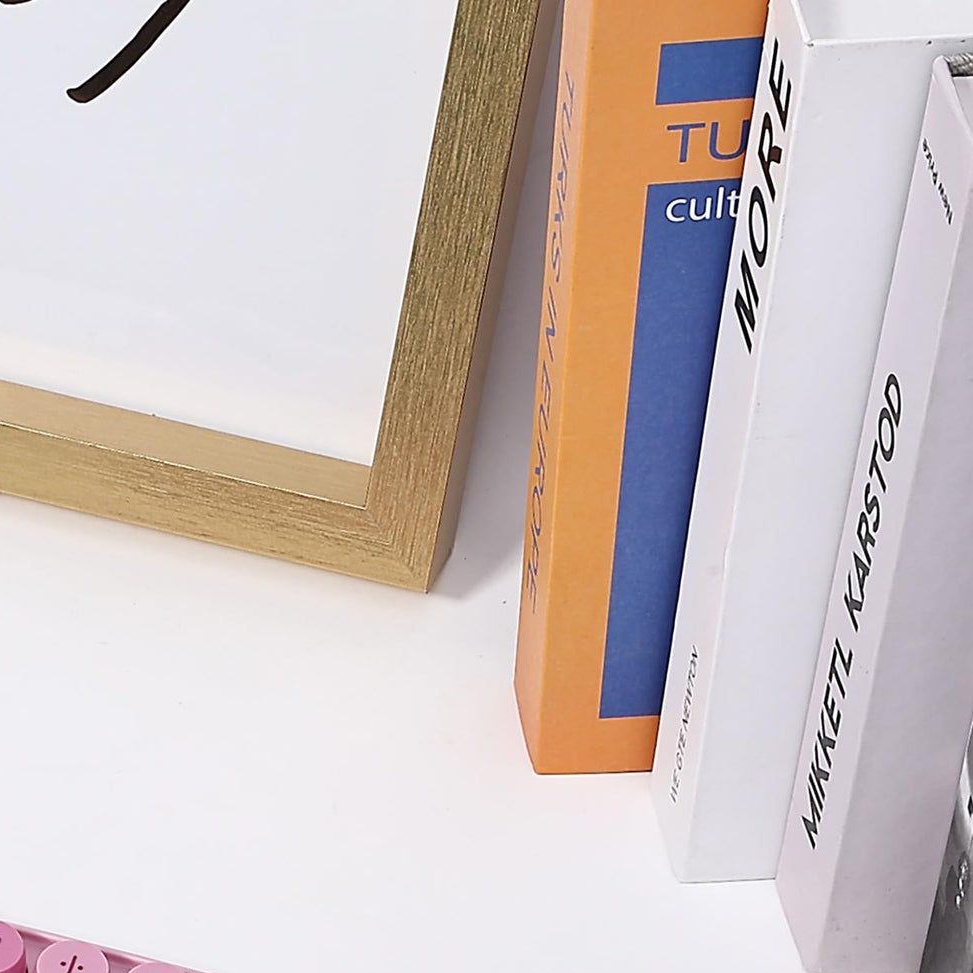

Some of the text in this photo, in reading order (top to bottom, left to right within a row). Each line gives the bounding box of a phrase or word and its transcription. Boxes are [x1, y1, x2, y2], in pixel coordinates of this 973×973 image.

[552, 71, 574, 282] TURKS
[734, 38, 792, 354] MORE
[527, 360, 551, 614] EUROPE
[802, 374, 901, 849] MIKKETL KARSTOD
